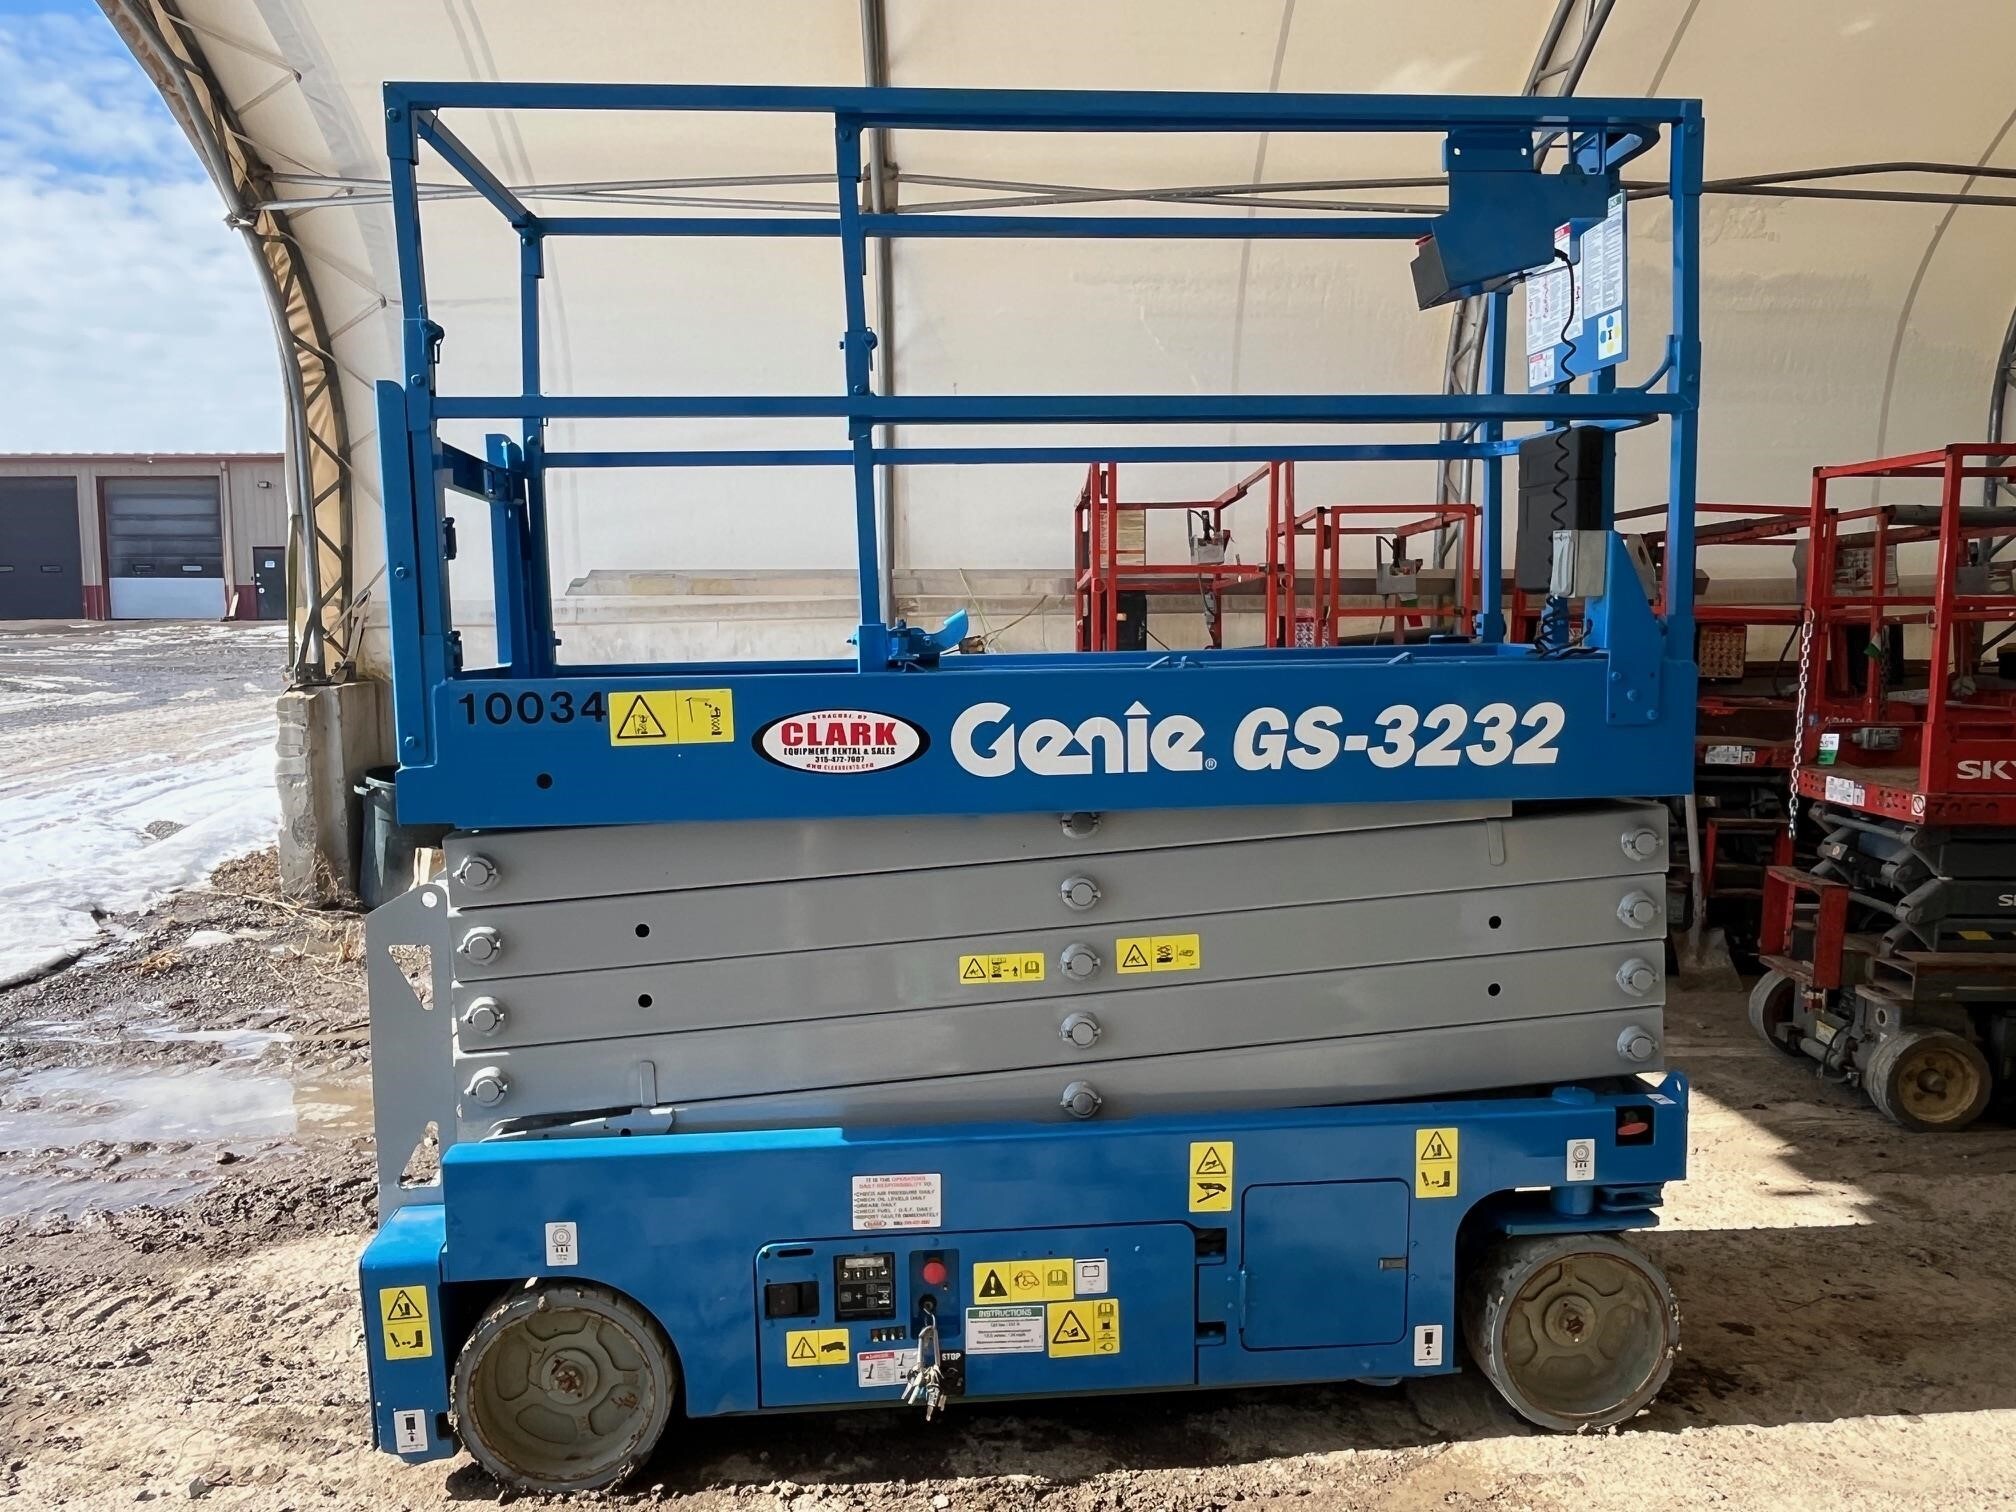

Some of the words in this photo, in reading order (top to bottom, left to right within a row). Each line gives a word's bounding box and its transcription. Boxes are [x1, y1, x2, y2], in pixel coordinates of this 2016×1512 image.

[458, 691, 607, 725] 10034
[781, 722, 898, 747] CLARK
[950, 700, 1206, 777] Genie
[1233, 702, 1566, 771] GS-3232
[783, 747, 830, 756] EQUIPMENT
[832, 747, 861, 755] RENTAL
[871, 747, 896, 755] SALES
[979, 1308, 1032, 1317] INSTRUCTIONS
